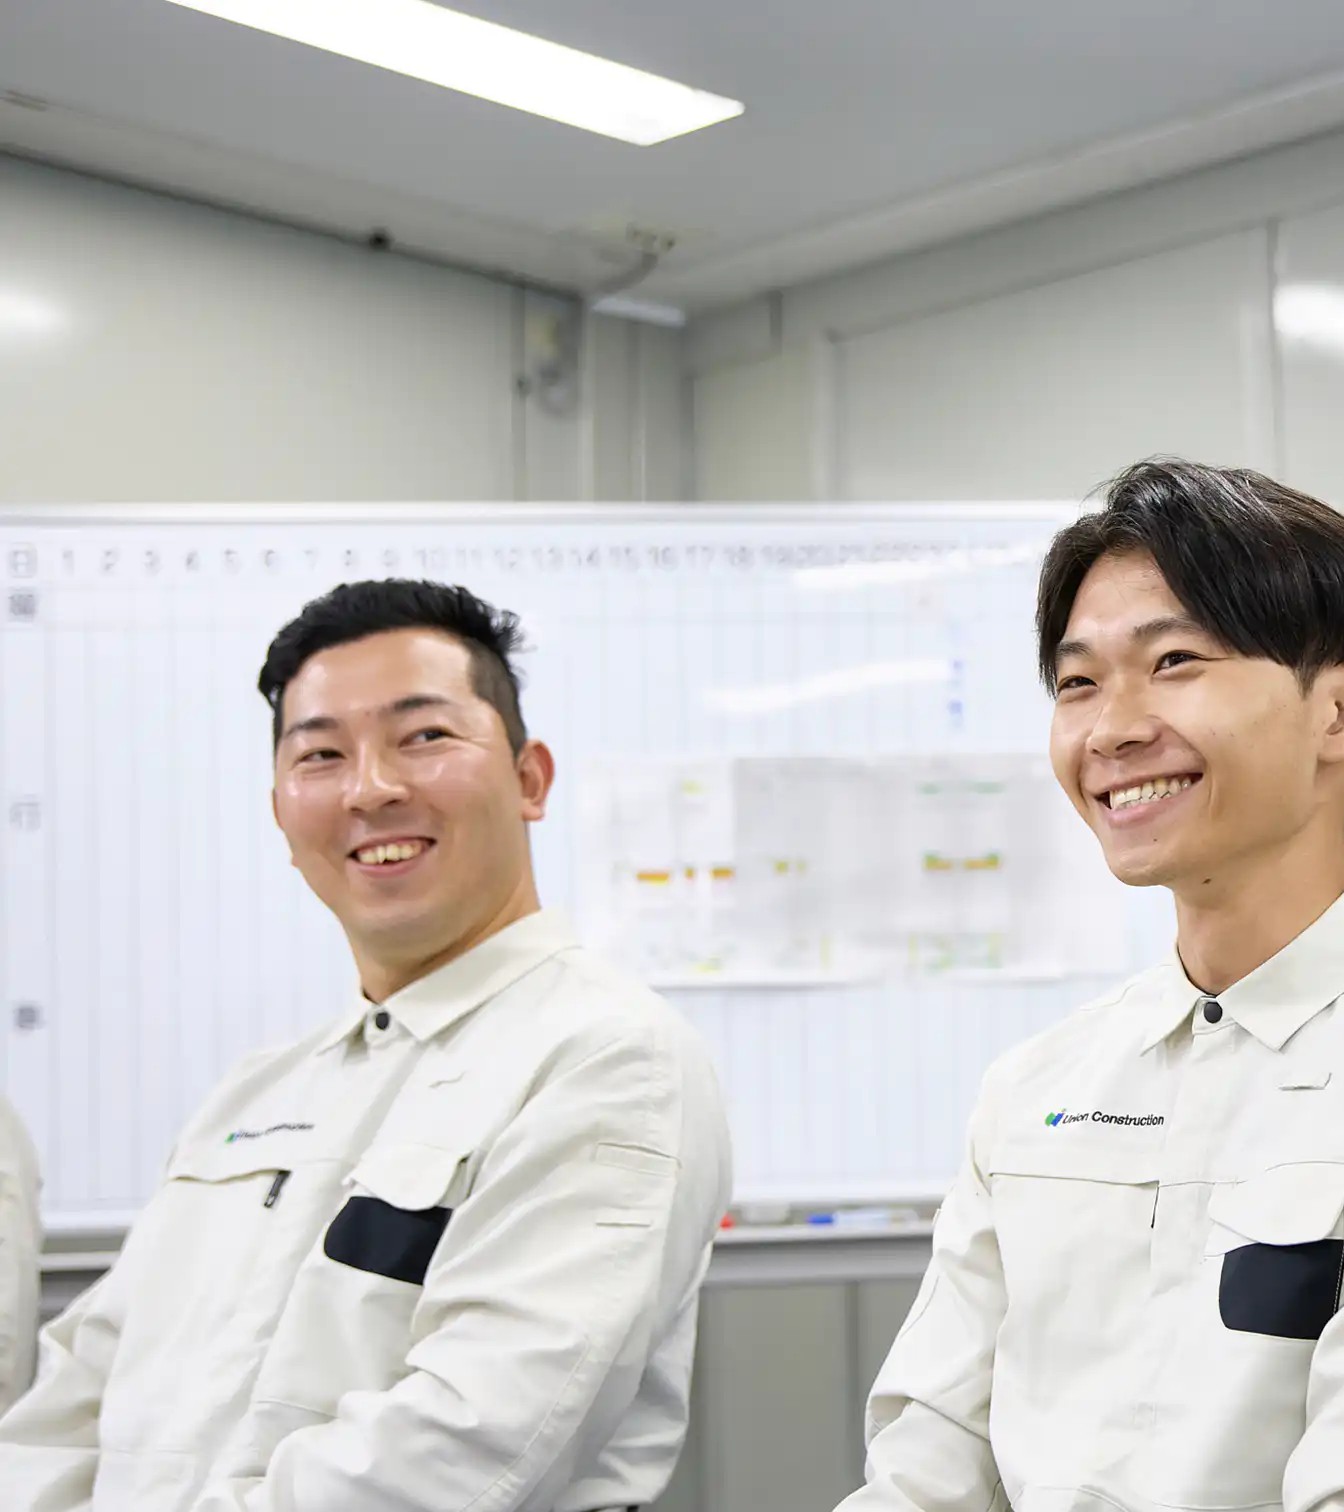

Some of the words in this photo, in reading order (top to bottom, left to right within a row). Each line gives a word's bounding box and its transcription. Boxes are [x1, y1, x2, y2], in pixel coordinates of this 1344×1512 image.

[100, 548, 120, 576] 2
[142, 548, 162, 576] 3
[1091, 1110, 1165, 1127] Construction
